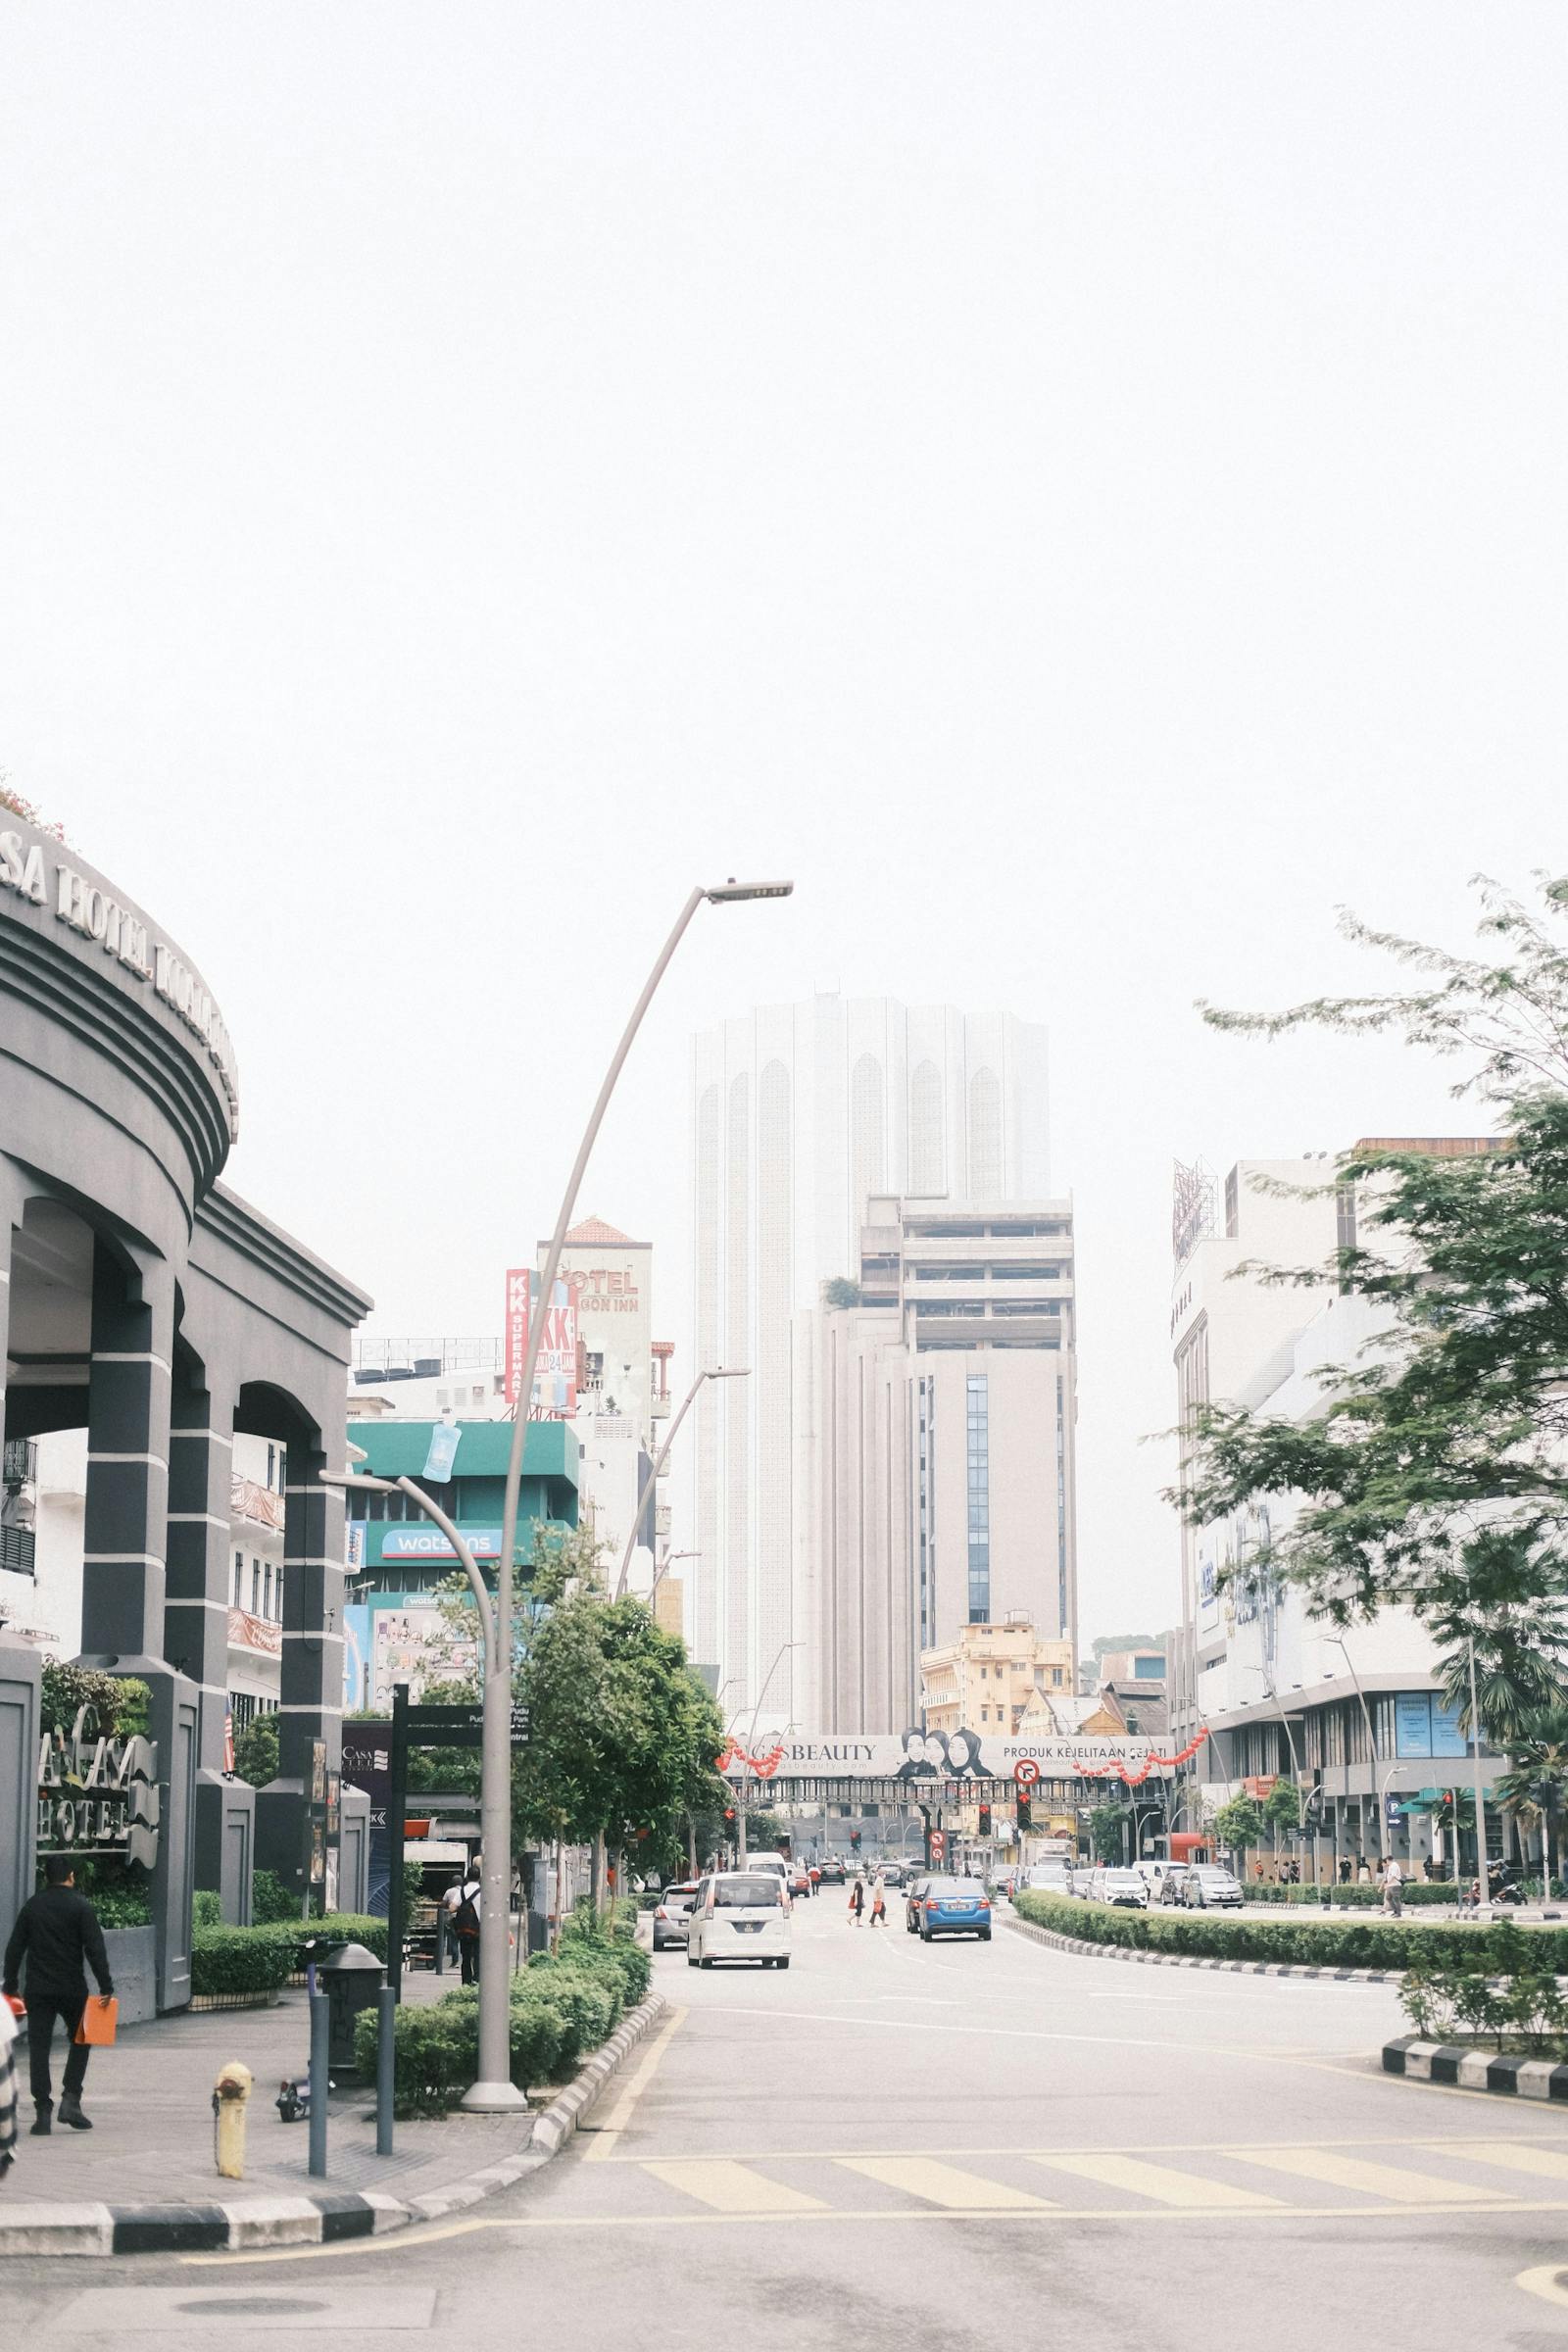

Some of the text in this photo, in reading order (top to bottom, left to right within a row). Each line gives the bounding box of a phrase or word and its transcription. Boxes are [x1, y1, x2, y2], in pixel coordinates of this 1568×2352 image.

[56, 864, 153, 982] HOTEL
[563, 1269, 639, 1295] OTEL
[509, 1276, 526, 1313] KK
[612, 1298, 639, 1312] INN
[549, 1354, 562, 1371] 24
[398, 1536, 491, 1550] watsns
[1004, 1746, 1053, 1758] PRODUK
[1057, 1746, 1126, 1758] KEJELITAAN
[1130, 1747, 1166, 1758] EJTI
[1390, 1802, 1399, 1813] P
[36, 1799, 129, 1841] HOTEL
